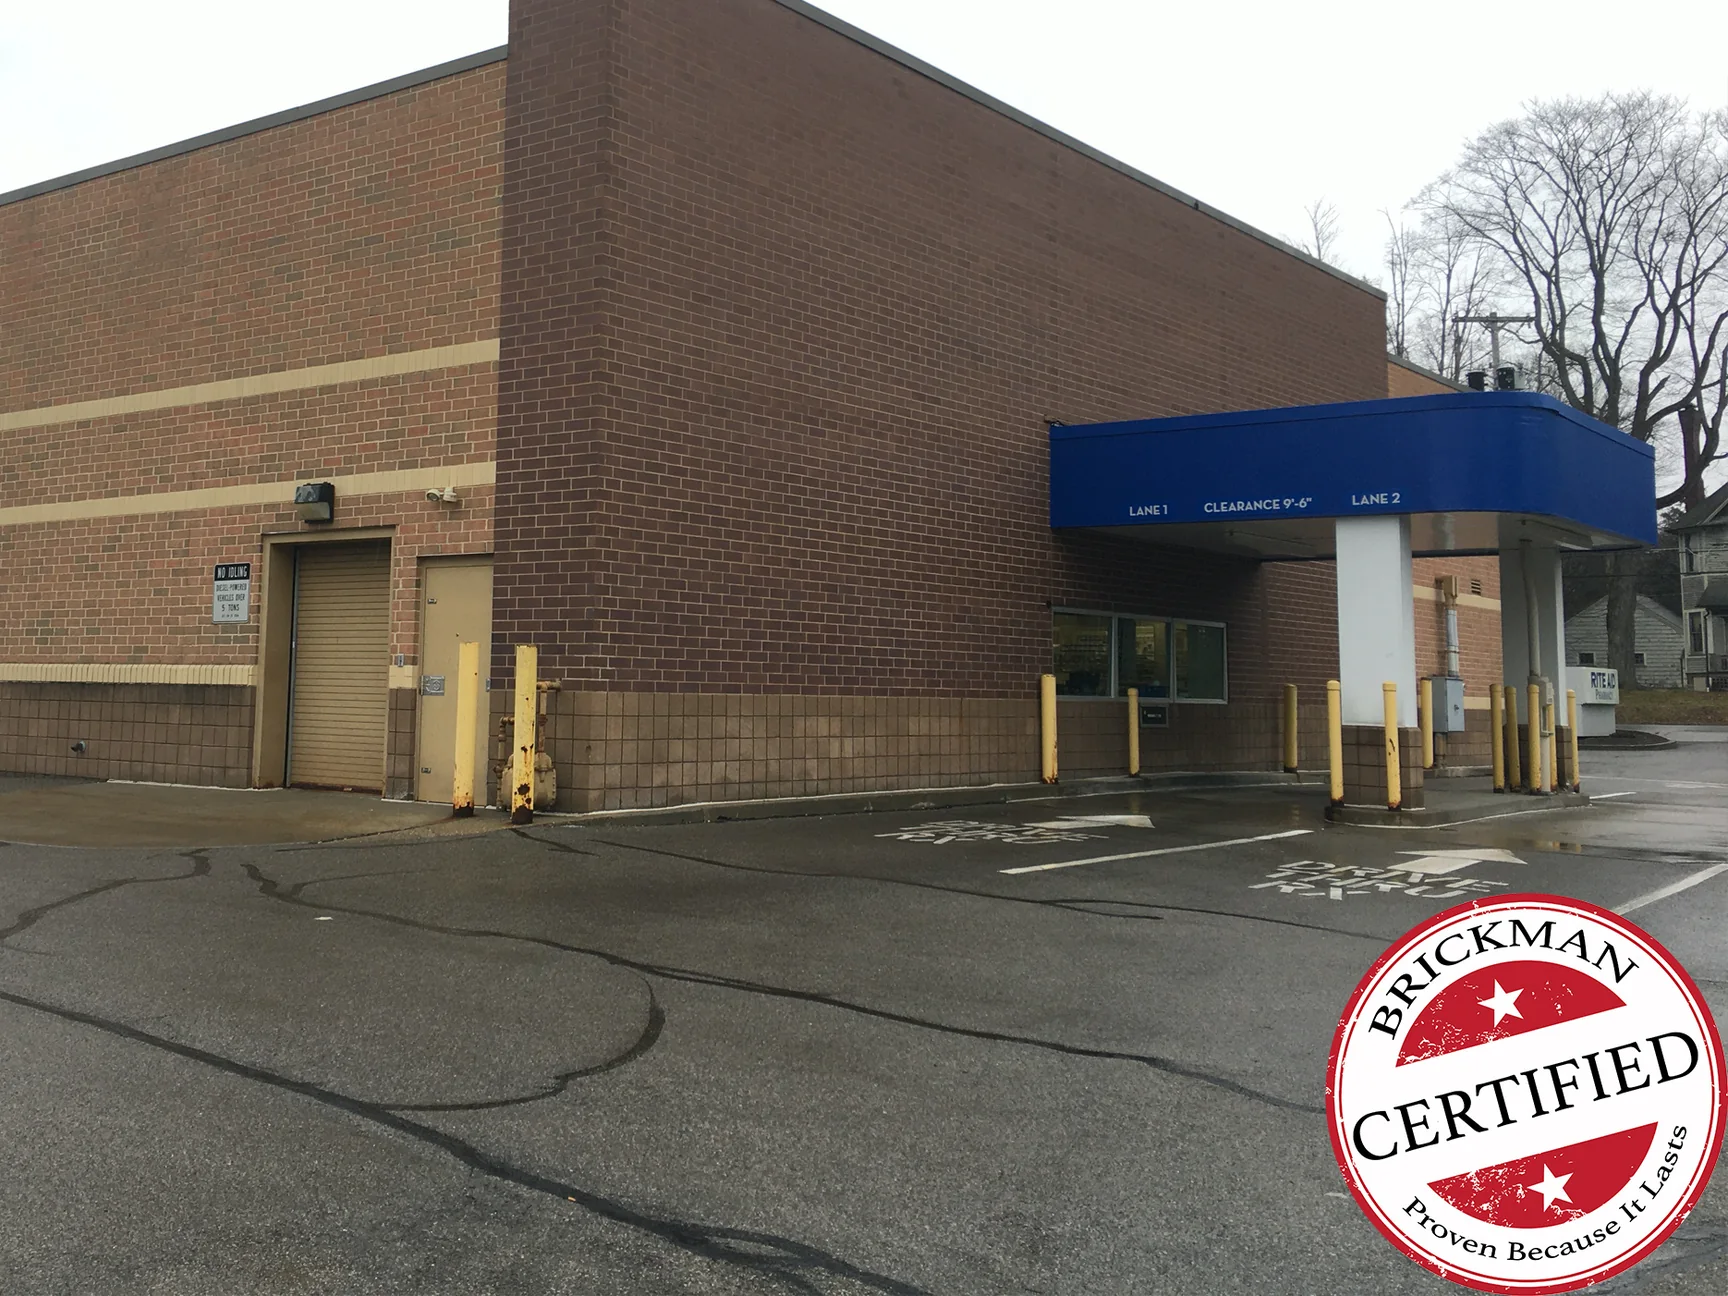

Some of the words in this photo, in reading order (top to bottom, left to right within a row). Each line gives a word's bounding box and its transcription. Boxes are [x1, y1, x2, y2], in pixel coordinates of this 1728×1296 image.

[1352, 493, 1389, 506] LANE
[1391, 492, 1401, 504] 2
[1129, 505, 1161, 517] LANE
[1162, 504, 1168, 515] 1
[1203, 499, 1281, 513] CLEARANCE
[217, 567, 226, 578] NO
[228, 566, 248, 578] IDLING
[217, 594, 234, 602] VEHICLES
[235, 593, 246, 601] OVER
[1591, 672, 1606, 688] RITE
